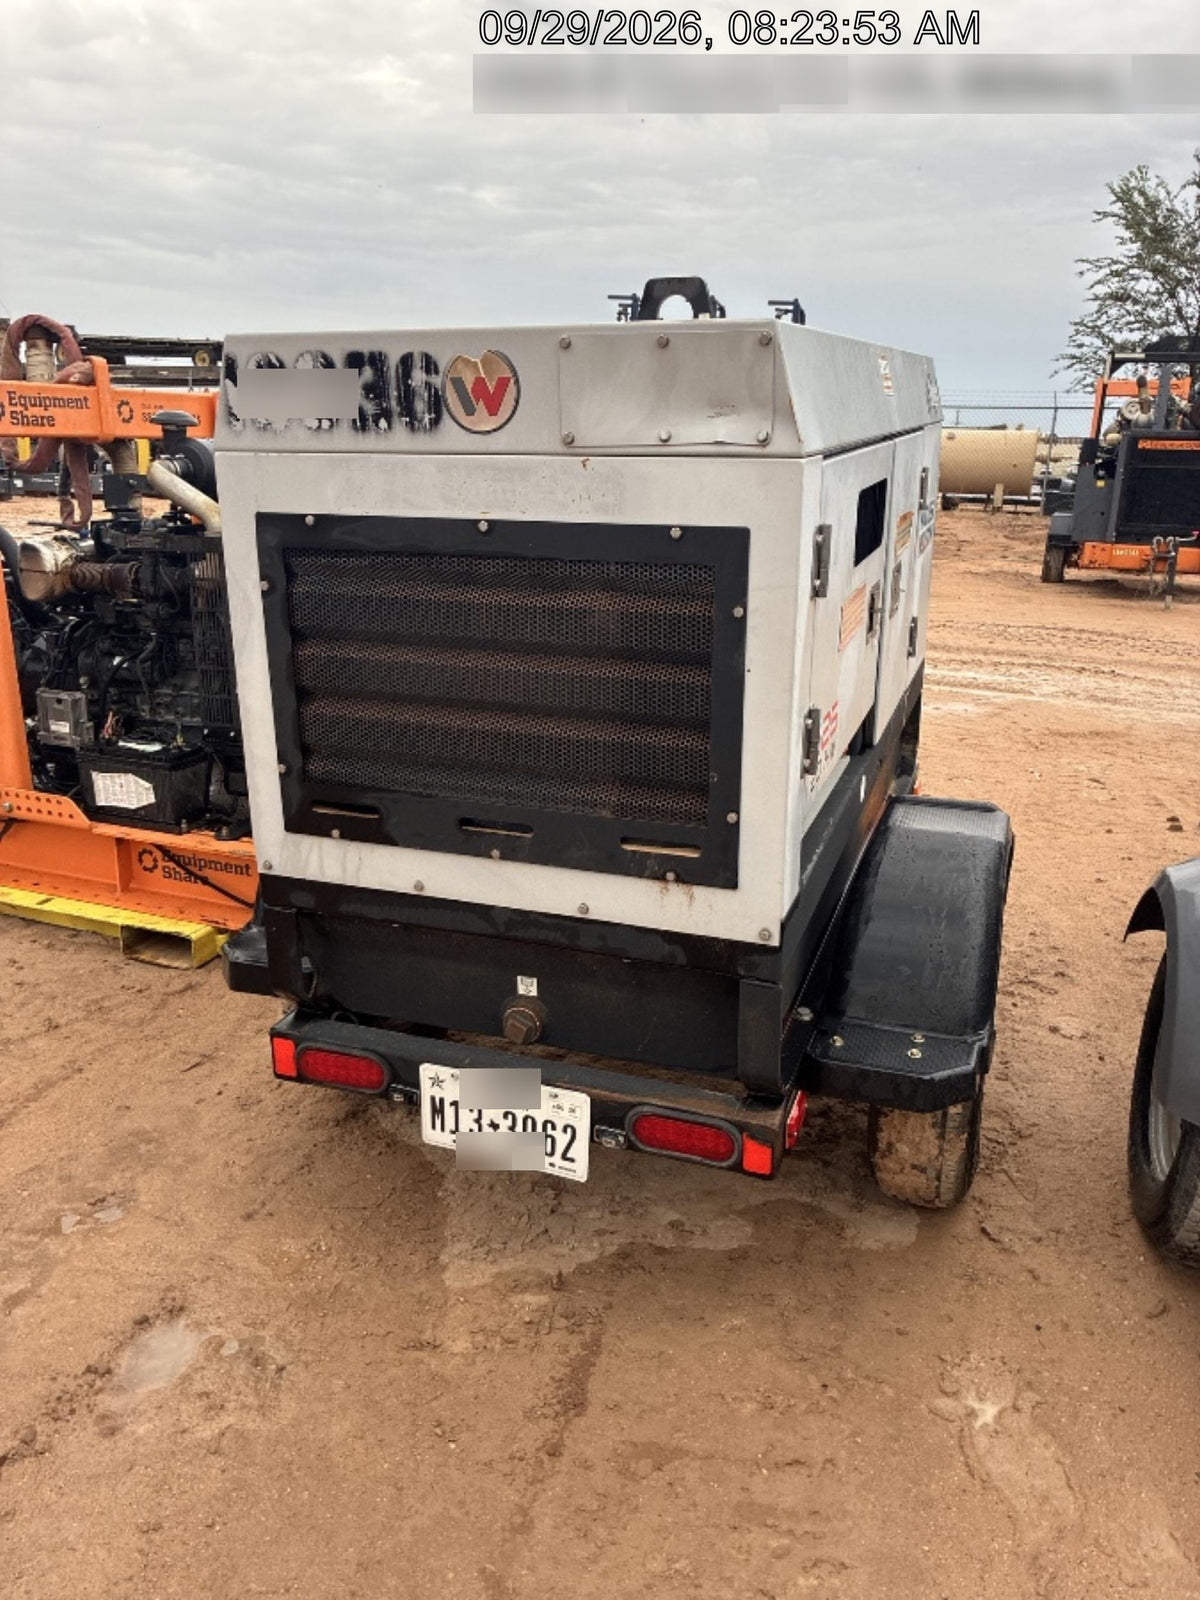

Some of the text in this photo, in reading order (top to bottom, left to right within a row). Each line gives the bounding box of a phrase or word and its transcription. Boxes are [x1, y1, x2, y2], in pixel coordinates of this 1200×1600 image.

[8, 391, 90, 411] Equipment
[10, 411, 56, 427] Share
[162, 866, 209, 886] Sha
